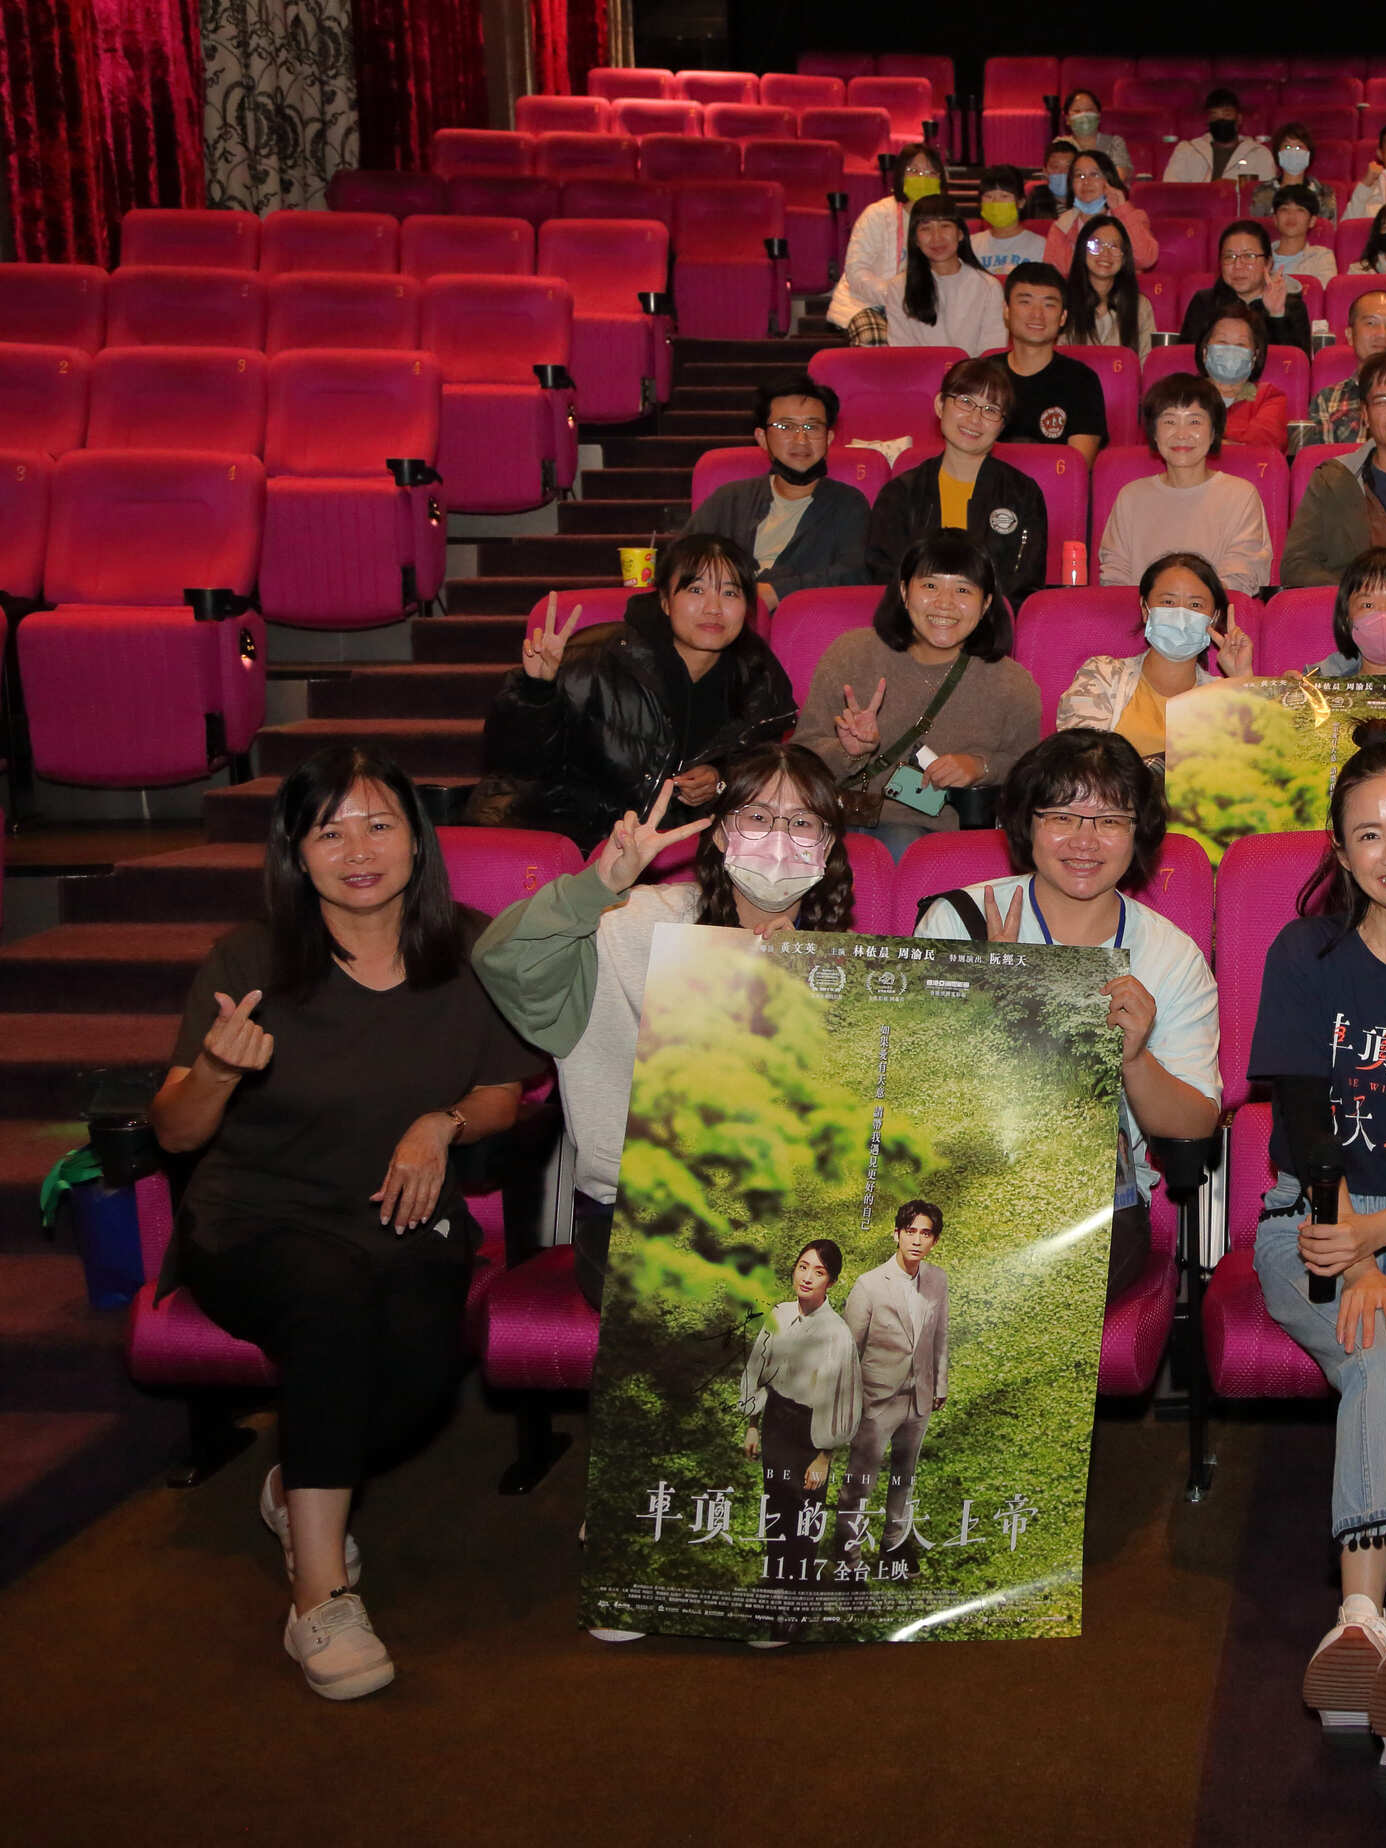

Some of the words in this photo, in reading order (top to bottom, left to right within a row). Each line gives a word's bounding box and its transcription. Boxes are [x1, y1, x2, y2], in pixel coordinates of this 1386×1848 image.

[1154, 283, 1163, 295] 6
[58, 360, 69, 374] 2
[1112, 360, 1123, 373] 6
[1283, 360, 1293, 373] 7
[16, 465, 26, 481] 3
[856, 464, 866, 481] 5
[1056, 458, 1066, 475] 6
[1256, 462, 1268, 479] 7
[523, 866, 539, 891] 5
[1159, 868, 1175, 893] 7
[853, 945, 889, 959] 林依晨
[898, 948, 935, 961] 周渝民
[989, 952, 1027, 967] 阮經天
[766, 1468, 791, 1481] BE
[811, 1470, 872, 1486] WITH
[891, 1473, 919, 1486] ME
[635, 1480, 1039, 1553] 車頂上的玄天上帝
[760, 1555, 828, 1583] 11.17
[833, 1558, 910, 1583] 全台上映
